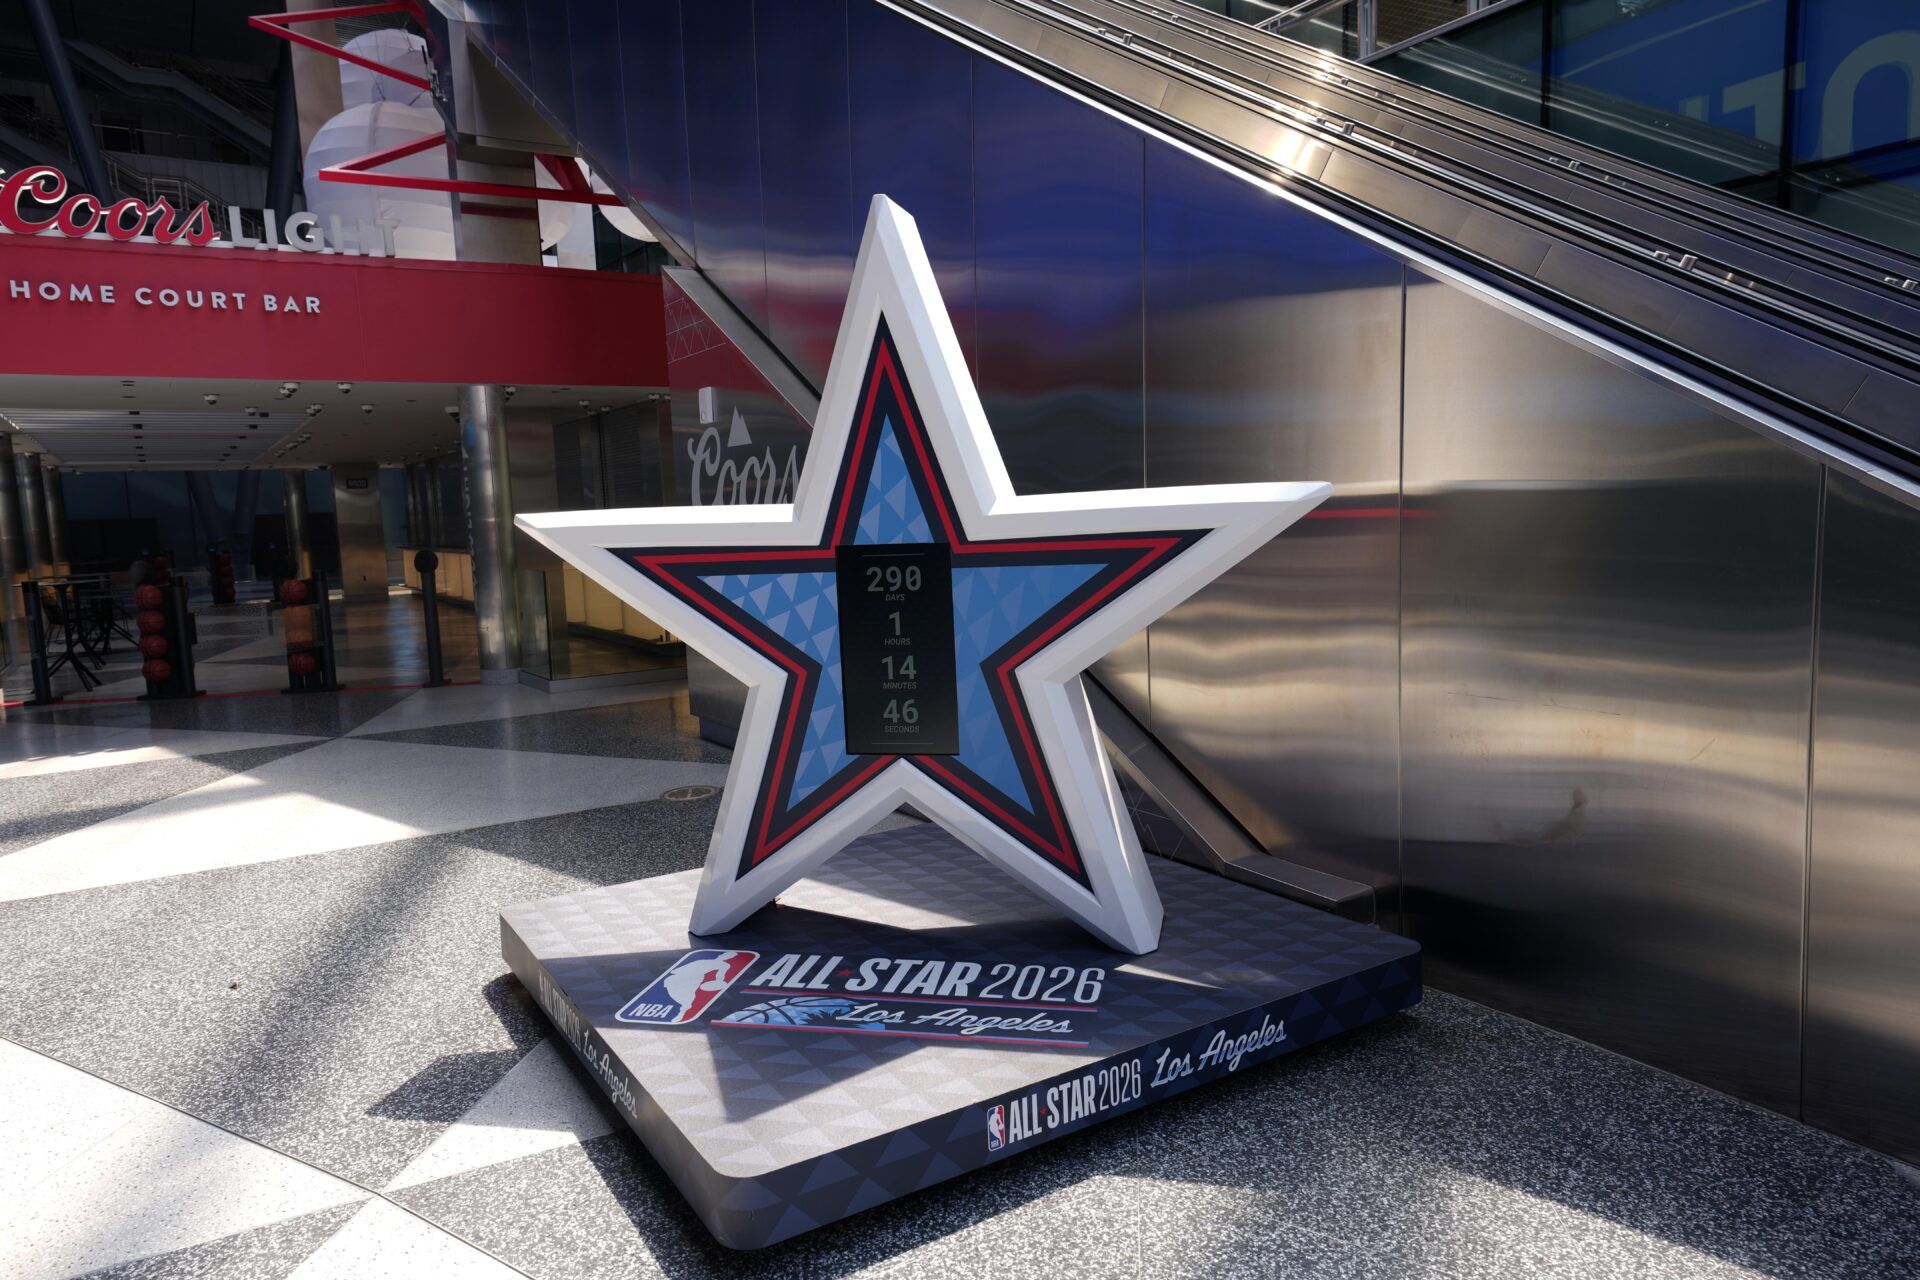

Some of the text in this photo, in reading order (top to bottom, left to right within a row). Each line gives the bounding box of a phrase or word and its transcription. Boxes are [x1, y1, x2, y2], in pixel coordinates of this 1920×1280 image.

[0, 165, 402, 257] Coors LIGHT
[9, 280, 321, 313] HOME COURT BAR
[866, 565, 922, 592] 290
[885, 593, 906, 601] DAYS
[889, 611, 901, 636] 1
[884, 637, 911, 646] HOURS
[881, 655, 917, 680] 14
[882, 681, 917, 690] MINUTES
[883, 699, 919, 724] 46
[884, 725, 920, 733] SECONDS
[749, 953, 1106, 1004] ALL STAR 2026
[629, 1003, 674, 1019] NBA
[836, 1003, 1074, 1035] Los Angeles
[583, 1029, 599, 1070] Los
[600, 1053, 638, 1119] Angeles
[1009, 1014, 1287, 1144] ALL STAR 2026 Los Angeles
